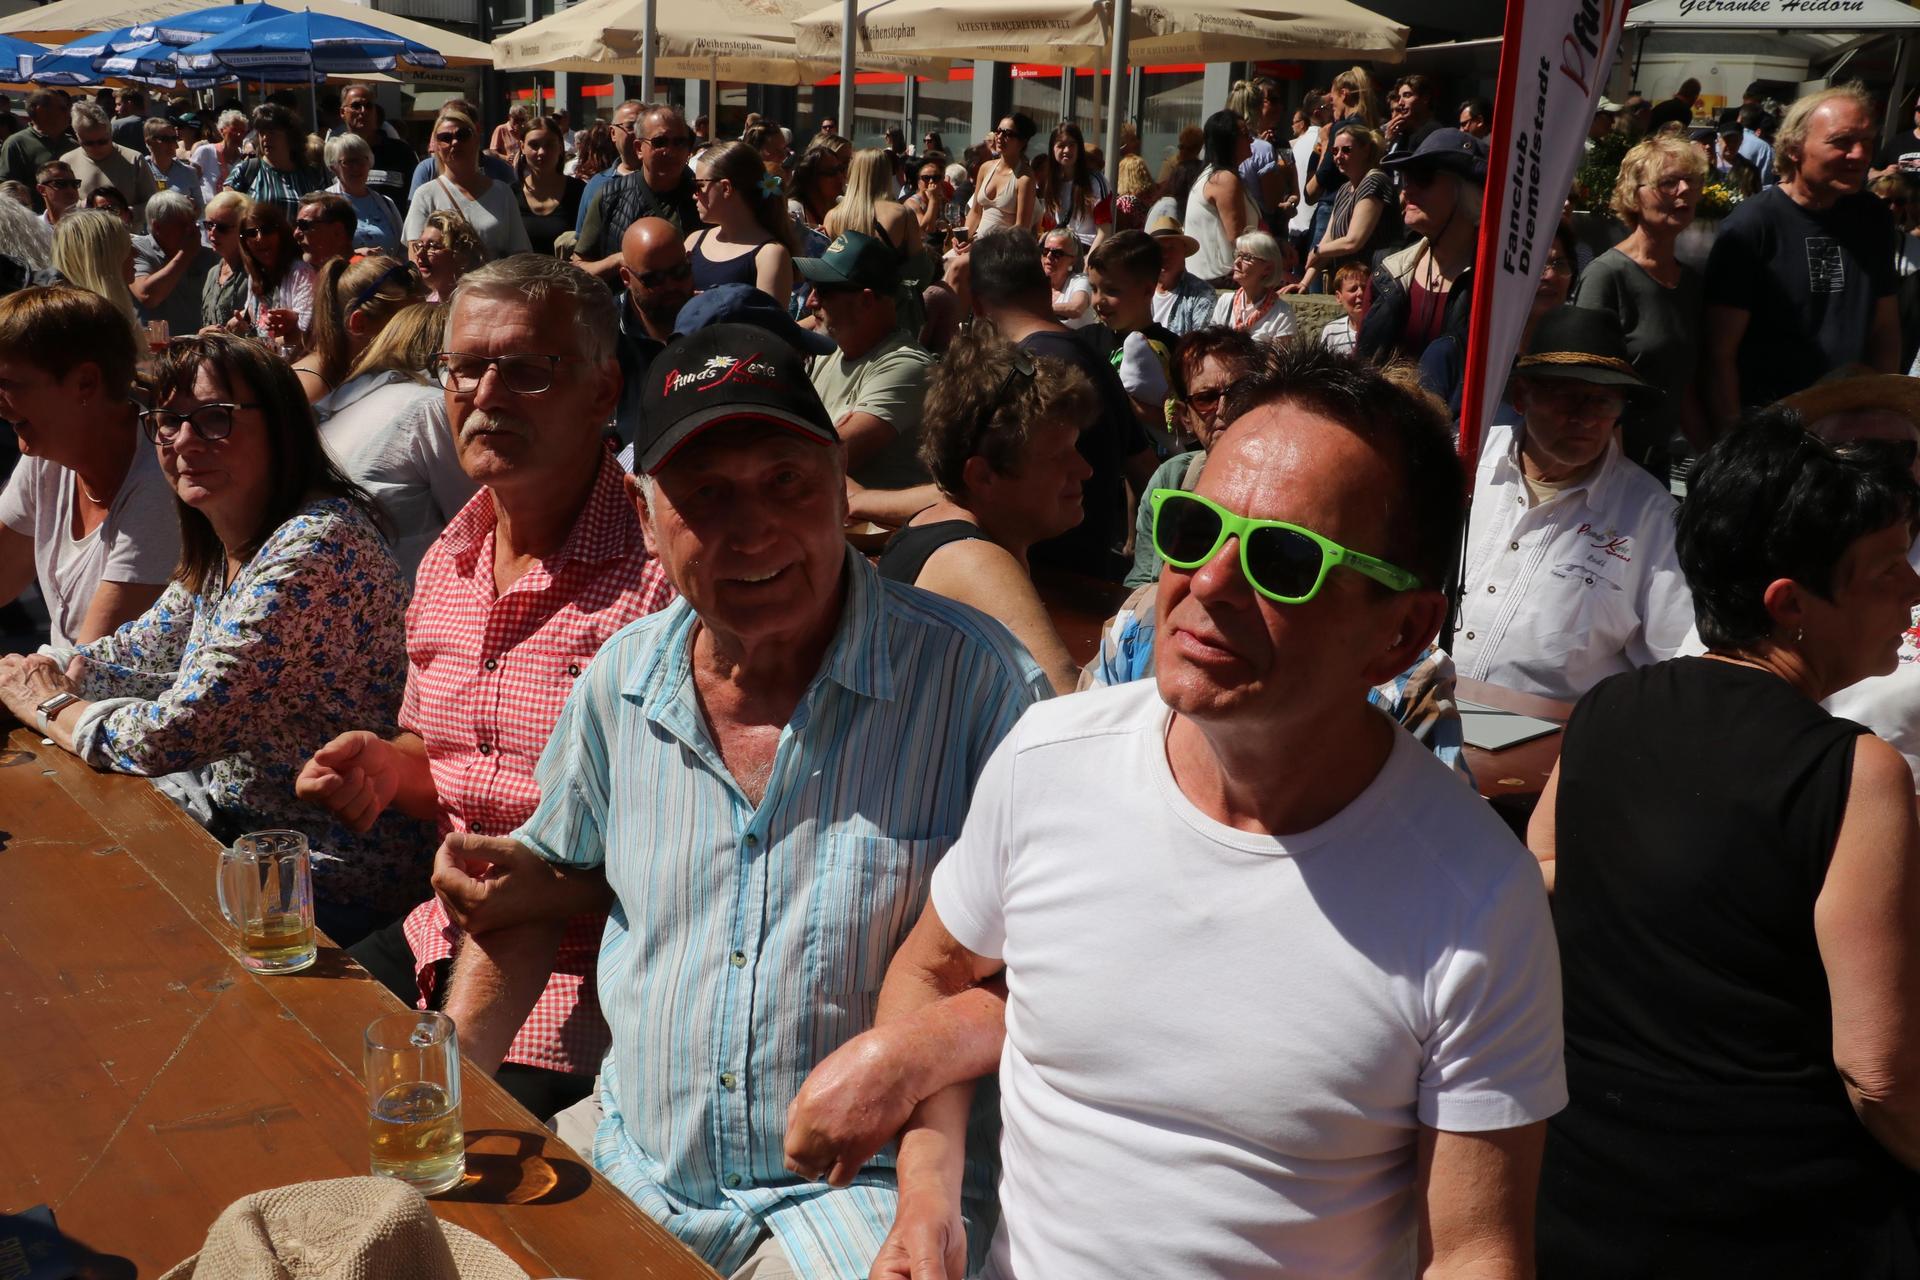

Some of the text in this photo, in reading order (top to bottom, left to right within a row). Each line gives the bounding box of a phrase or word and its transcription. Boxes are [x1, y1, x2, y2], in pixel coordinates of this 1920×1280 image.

[1781, 0, 1864, 12] Heidorn
[1031, 19, 1048, 30] DER
[1048, 19, 1071, 30] WELT
[696, 37, 762, 51] Weihenstephan
[1518, 55, 1551, 277] Diemelstadt
[1503, 130, 1528, 275] Fanclub
[662, 367, 718, 397] Pfunds
